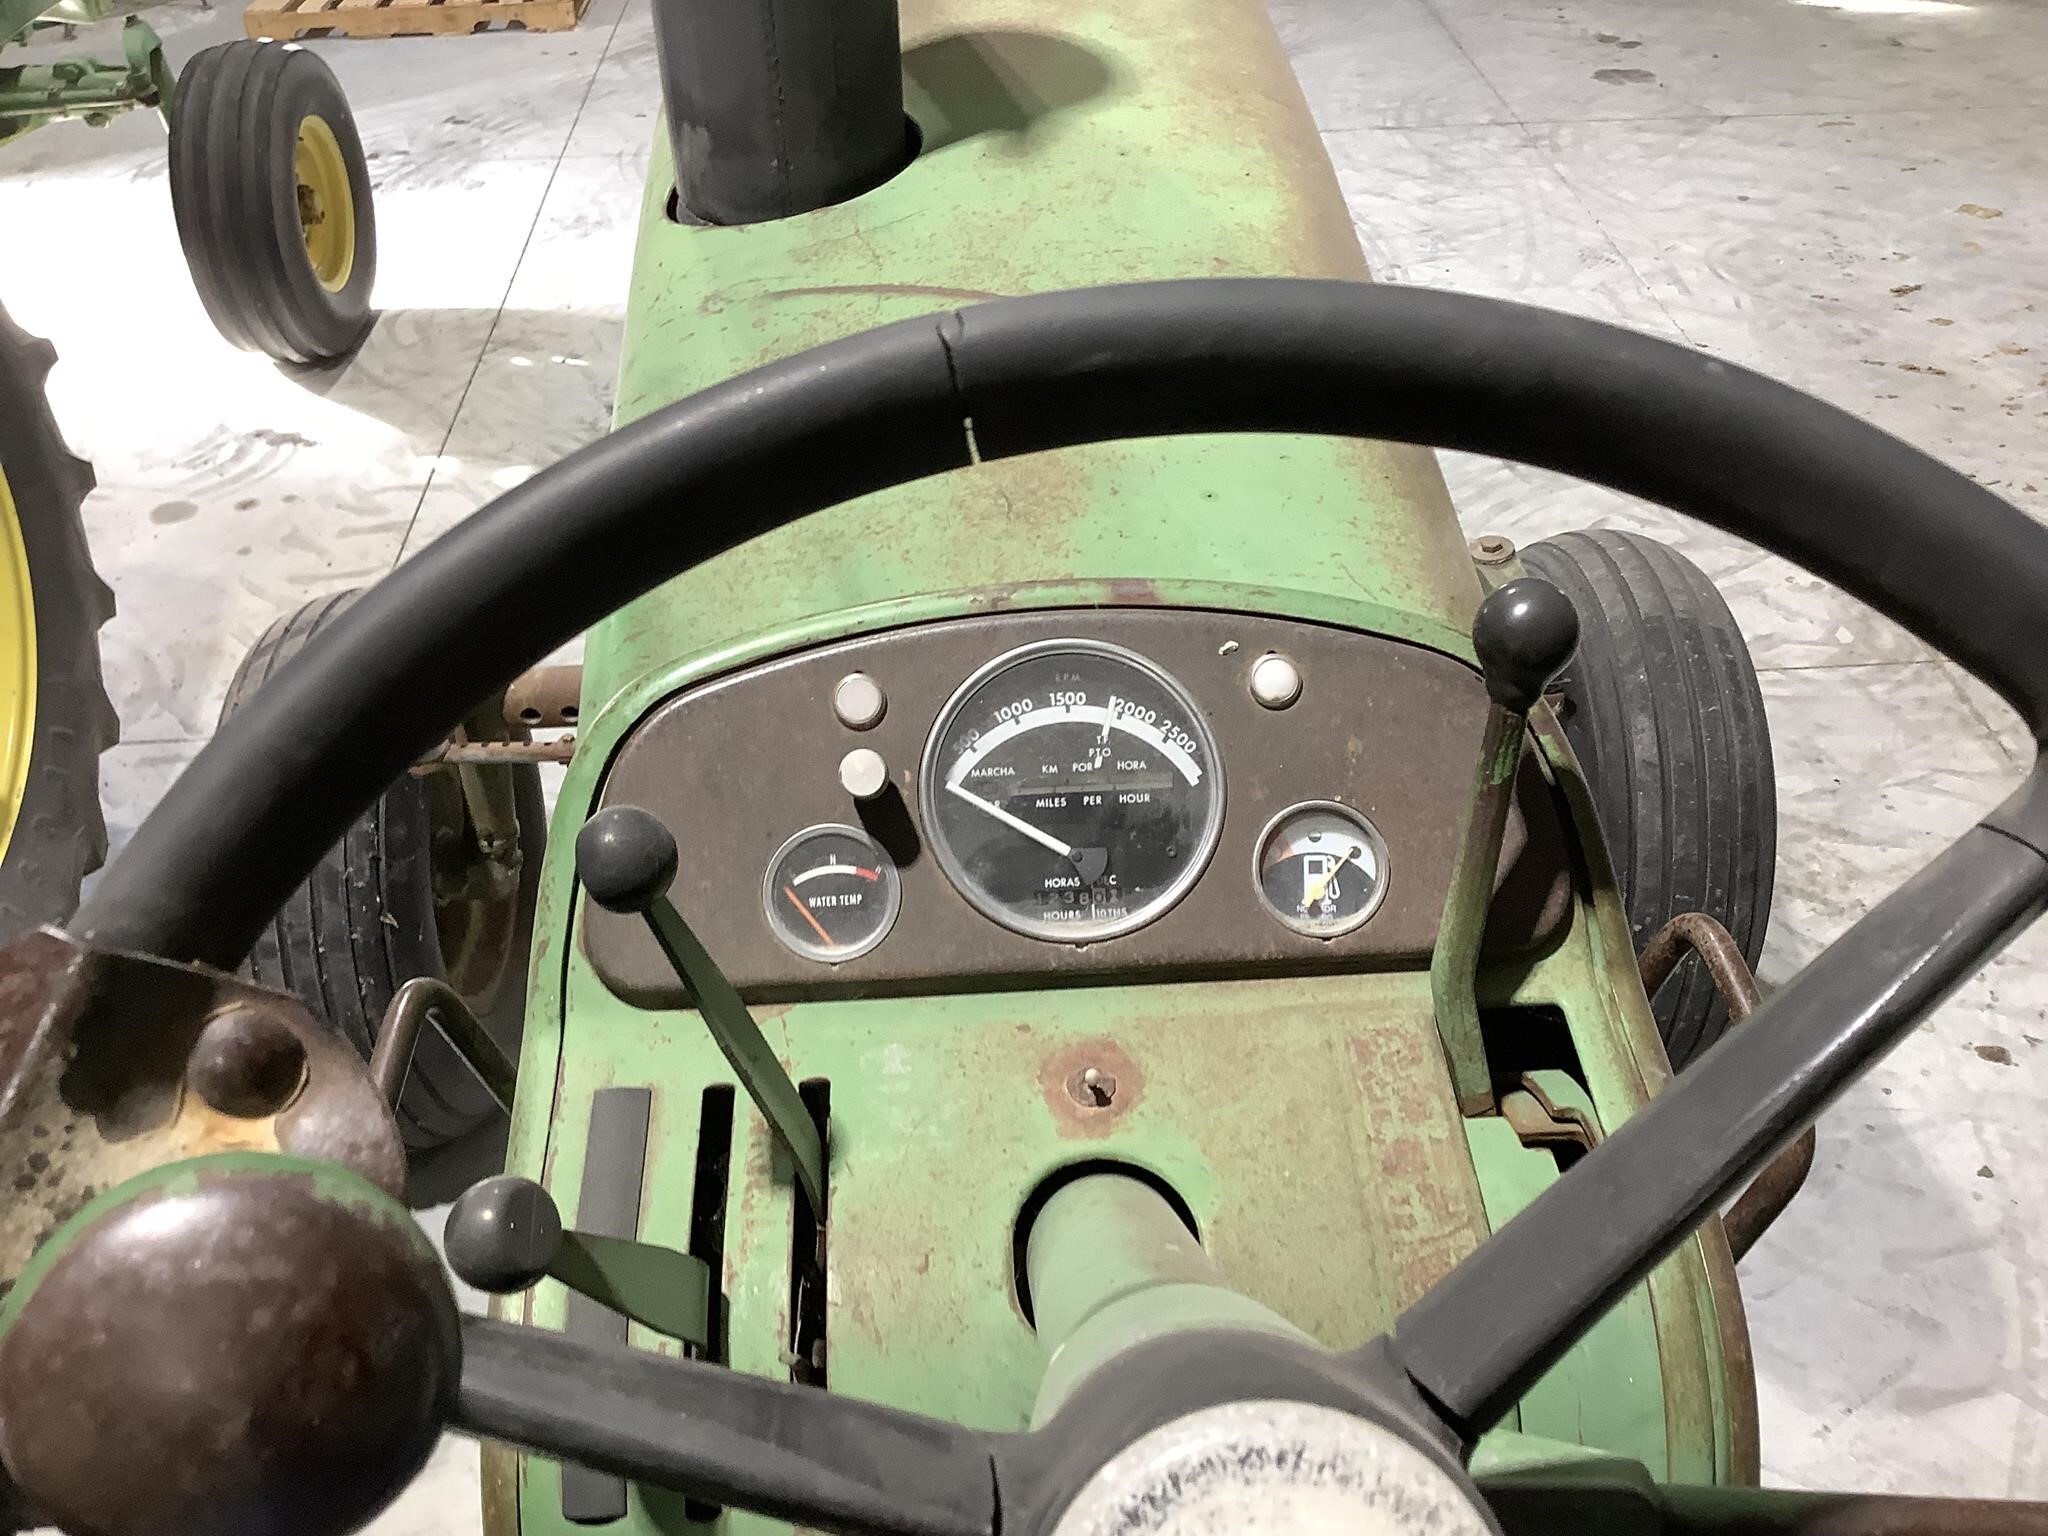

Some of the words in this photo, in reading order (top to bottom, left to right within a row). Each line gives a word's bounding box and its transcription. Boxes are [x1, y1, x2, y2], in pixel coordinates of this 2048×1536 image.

[1049, 691, 1087, 706] 1500
[993, 698, 1033, 725] 1000
[1115, 698, 1156, 724] 2000
[1160, 719, 1197, 754] 2500
[1088, 747, 1112, 758] PTO
[971, 766, 1016, 778] MARCHA
[1042, 764, 1058, 774] KM
[1072, 762, 1093, 773] POR
[1117, 760, 1147, 771] HORA
[1036, 797, 1067, 808] MILES
[1083, 795, 1102, 806] PER
[1119, 793, 1151, 804] HOUR
[1044, 876, 1081, 889] HORAS
[809, 896, 837, 908] WATER
[839, 894, 863, 906] TEMP
[1043, 909, 1082, 921] HOURS
